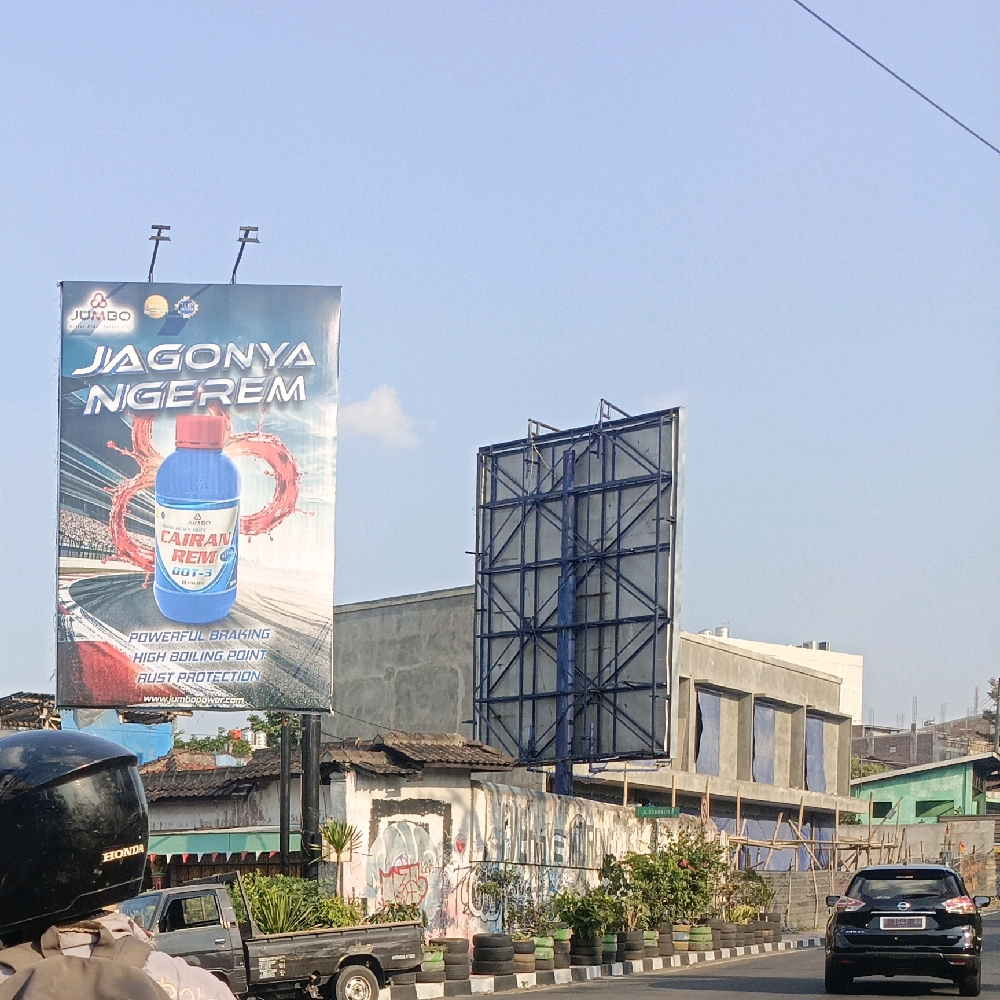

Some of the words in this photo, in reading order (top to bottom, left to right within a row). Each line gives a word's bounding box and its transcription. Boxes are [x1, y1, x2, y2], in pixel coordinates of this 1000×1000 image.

[69, 310, 132, 321] JUMBO
[71, 341, 317, 377] JAGONYA
[83, 374, 307, 416] NGEREM
[160, 529, 232, 548] CAIRAN
[171, 548, 218, 565] REM
[171, 566, 213, 577] DOT-3
[129, 630, 205, 643] POWERFUL
[209, 629, 271, 641] BRAKING
[133, 652, 167, 663] HIGH
[170, 651, 223, 662] BOILING
[227, 649, 267, 661] POINT
[137, 672, 175, 684] RUST
[177, 670, 261, 683] PROTECTION
[143, 695, 245, 705] www.jumbopower.com
[101, 843, 145, 863] HONDA
